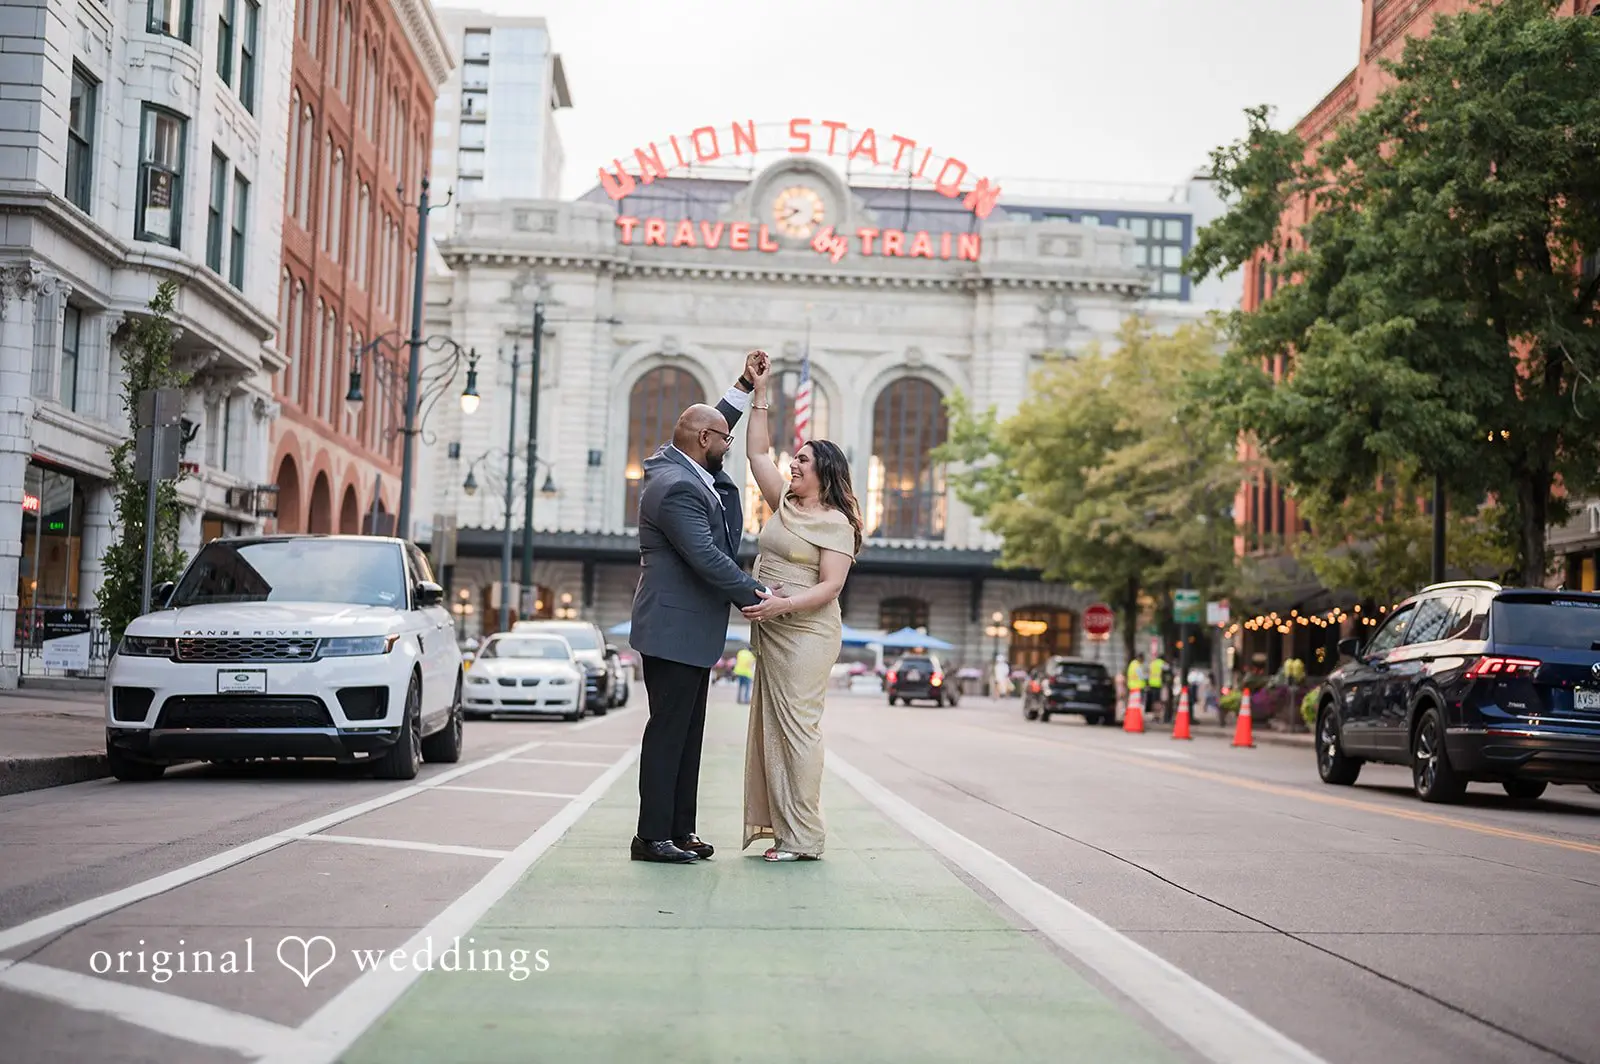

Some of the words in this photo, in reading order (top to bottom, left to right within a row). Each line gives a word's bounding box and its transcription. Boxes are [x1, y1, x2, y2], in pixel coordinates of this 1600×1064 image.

[598, 119, 759, 201] UNION
[788, 118, 1002, 220] STATION
[616, 216, 780, 253] TRAVEL
[811, 225, 849, 264] by
[856, 227, 983, 262] TRAIN
[1085, 614, 1113, 626] STOP
[1577, 693, 1600, 705] AVS-
